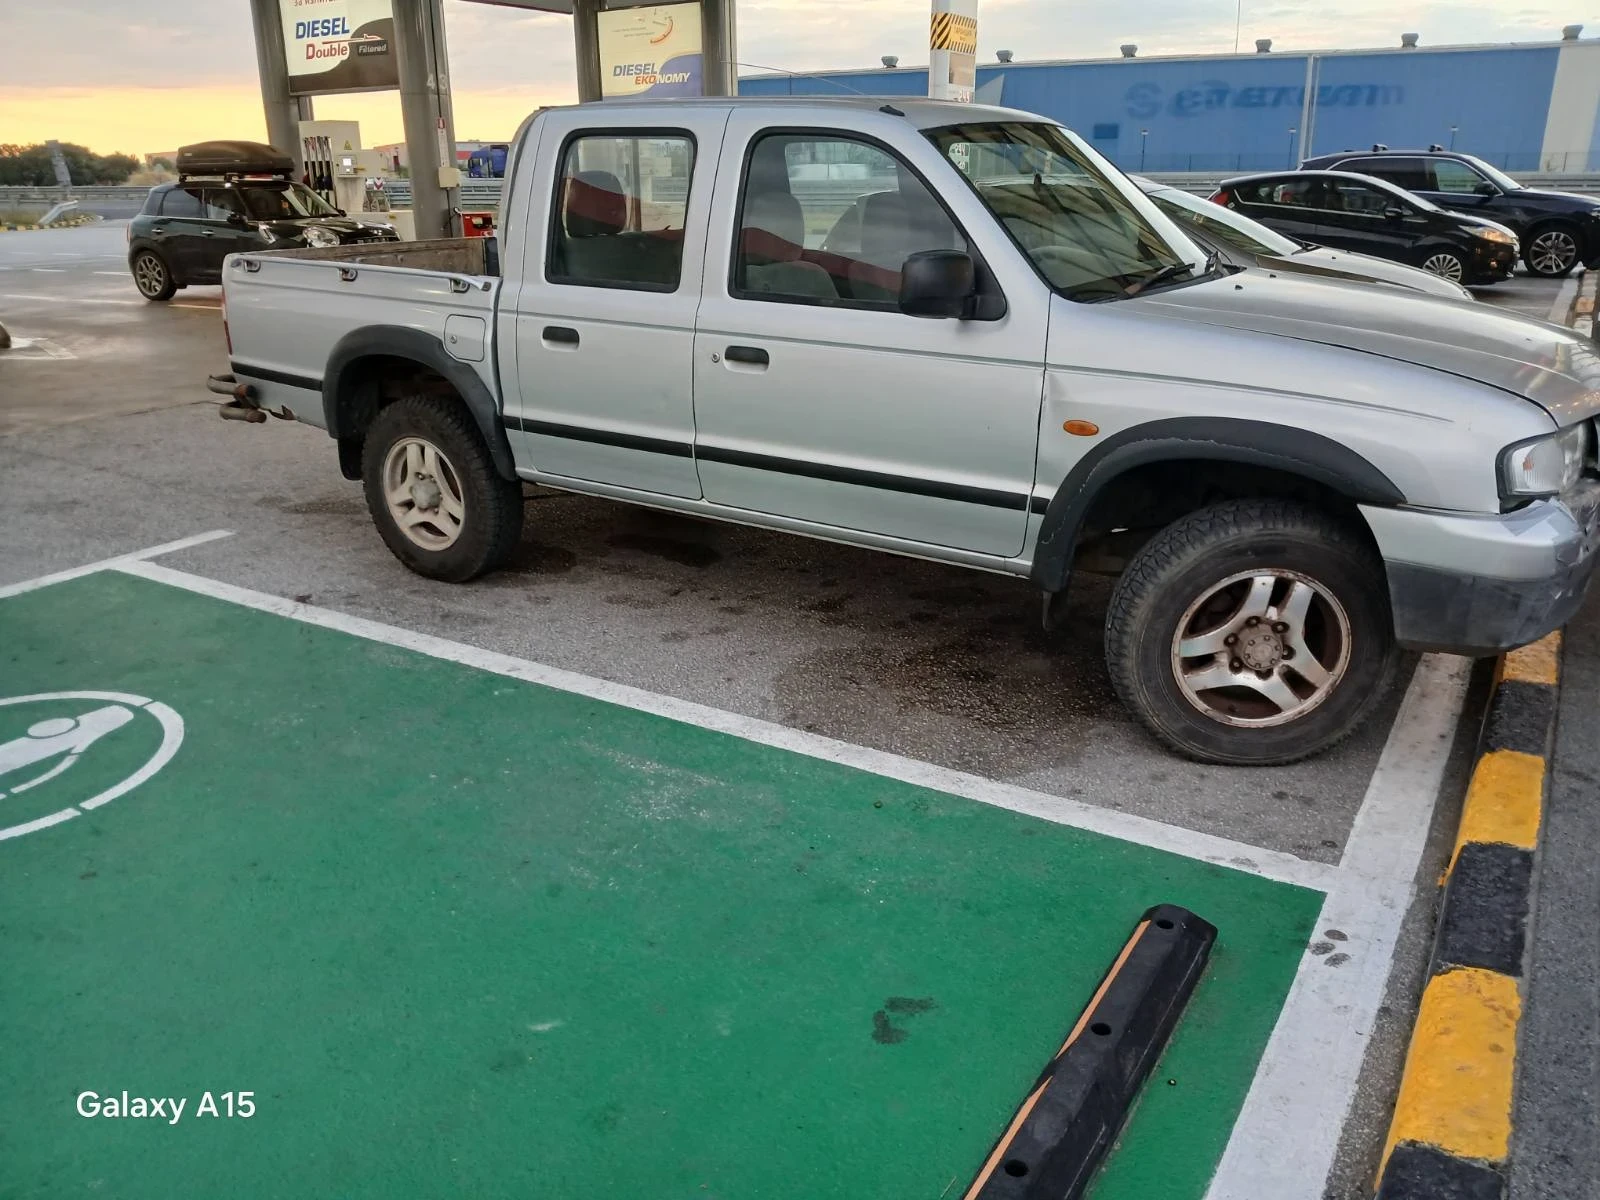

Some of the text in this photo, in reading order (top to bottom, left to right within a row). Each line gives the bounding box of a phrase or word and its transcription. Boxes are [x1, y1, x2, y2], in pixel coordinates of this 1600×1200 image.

[296, 17, 350, 39] DIESEL
[306, 42, 348, 60] Double
[613, 63, 658, 77] DIESEL
[635, 72, 691, 85] EKONOMY
